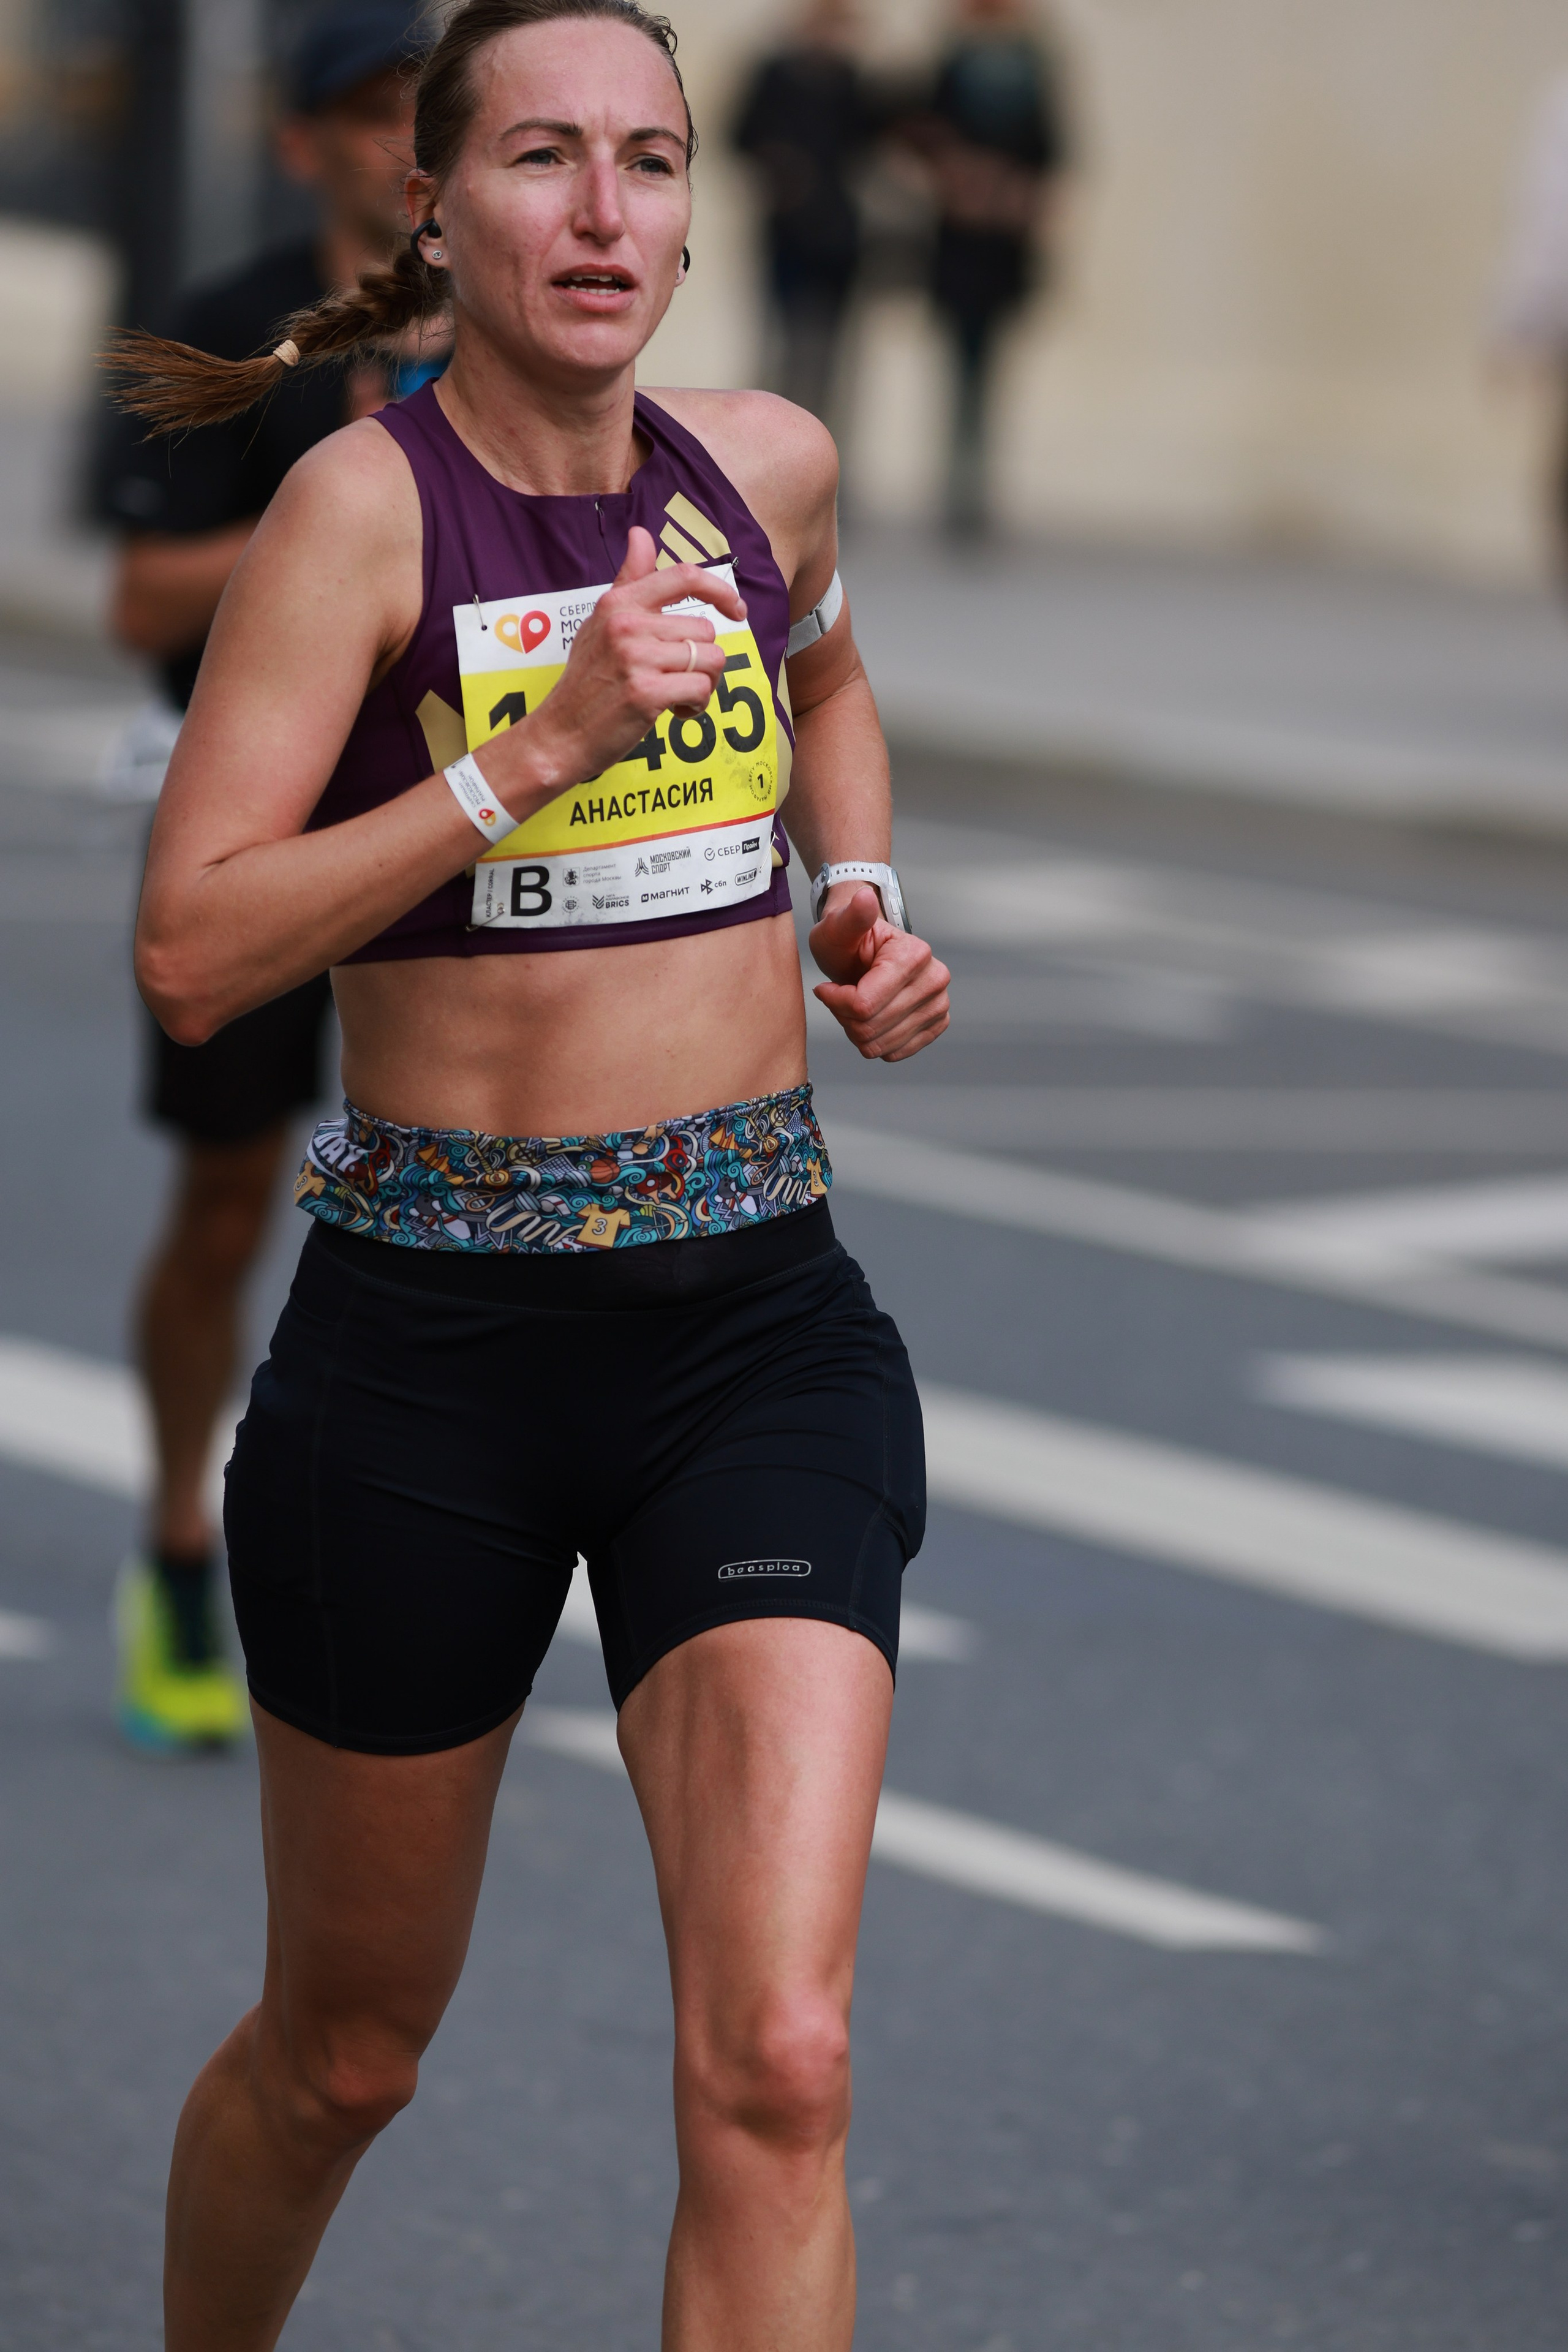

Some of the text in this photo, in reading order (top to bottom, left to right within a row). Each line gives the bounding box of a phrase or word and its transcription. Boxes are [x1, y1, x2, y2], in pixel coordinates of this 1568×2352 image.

[757, 773, 764, 789] 1
[569, 777, 713, 826] АНАСТАСИЯ
[650, 846, 691, 865] МОСКОВСКИЙ
[717, 841, 758, 856] СБЕР Прайм
[583, 864, 616, 872] Департамент
[652, 862, 671, 874] СПОРТ
[737, 871, 754, 883] WINLINE
[605, 899, 629, 908] BRICS
[592, 1218, 608, 1235] 3
